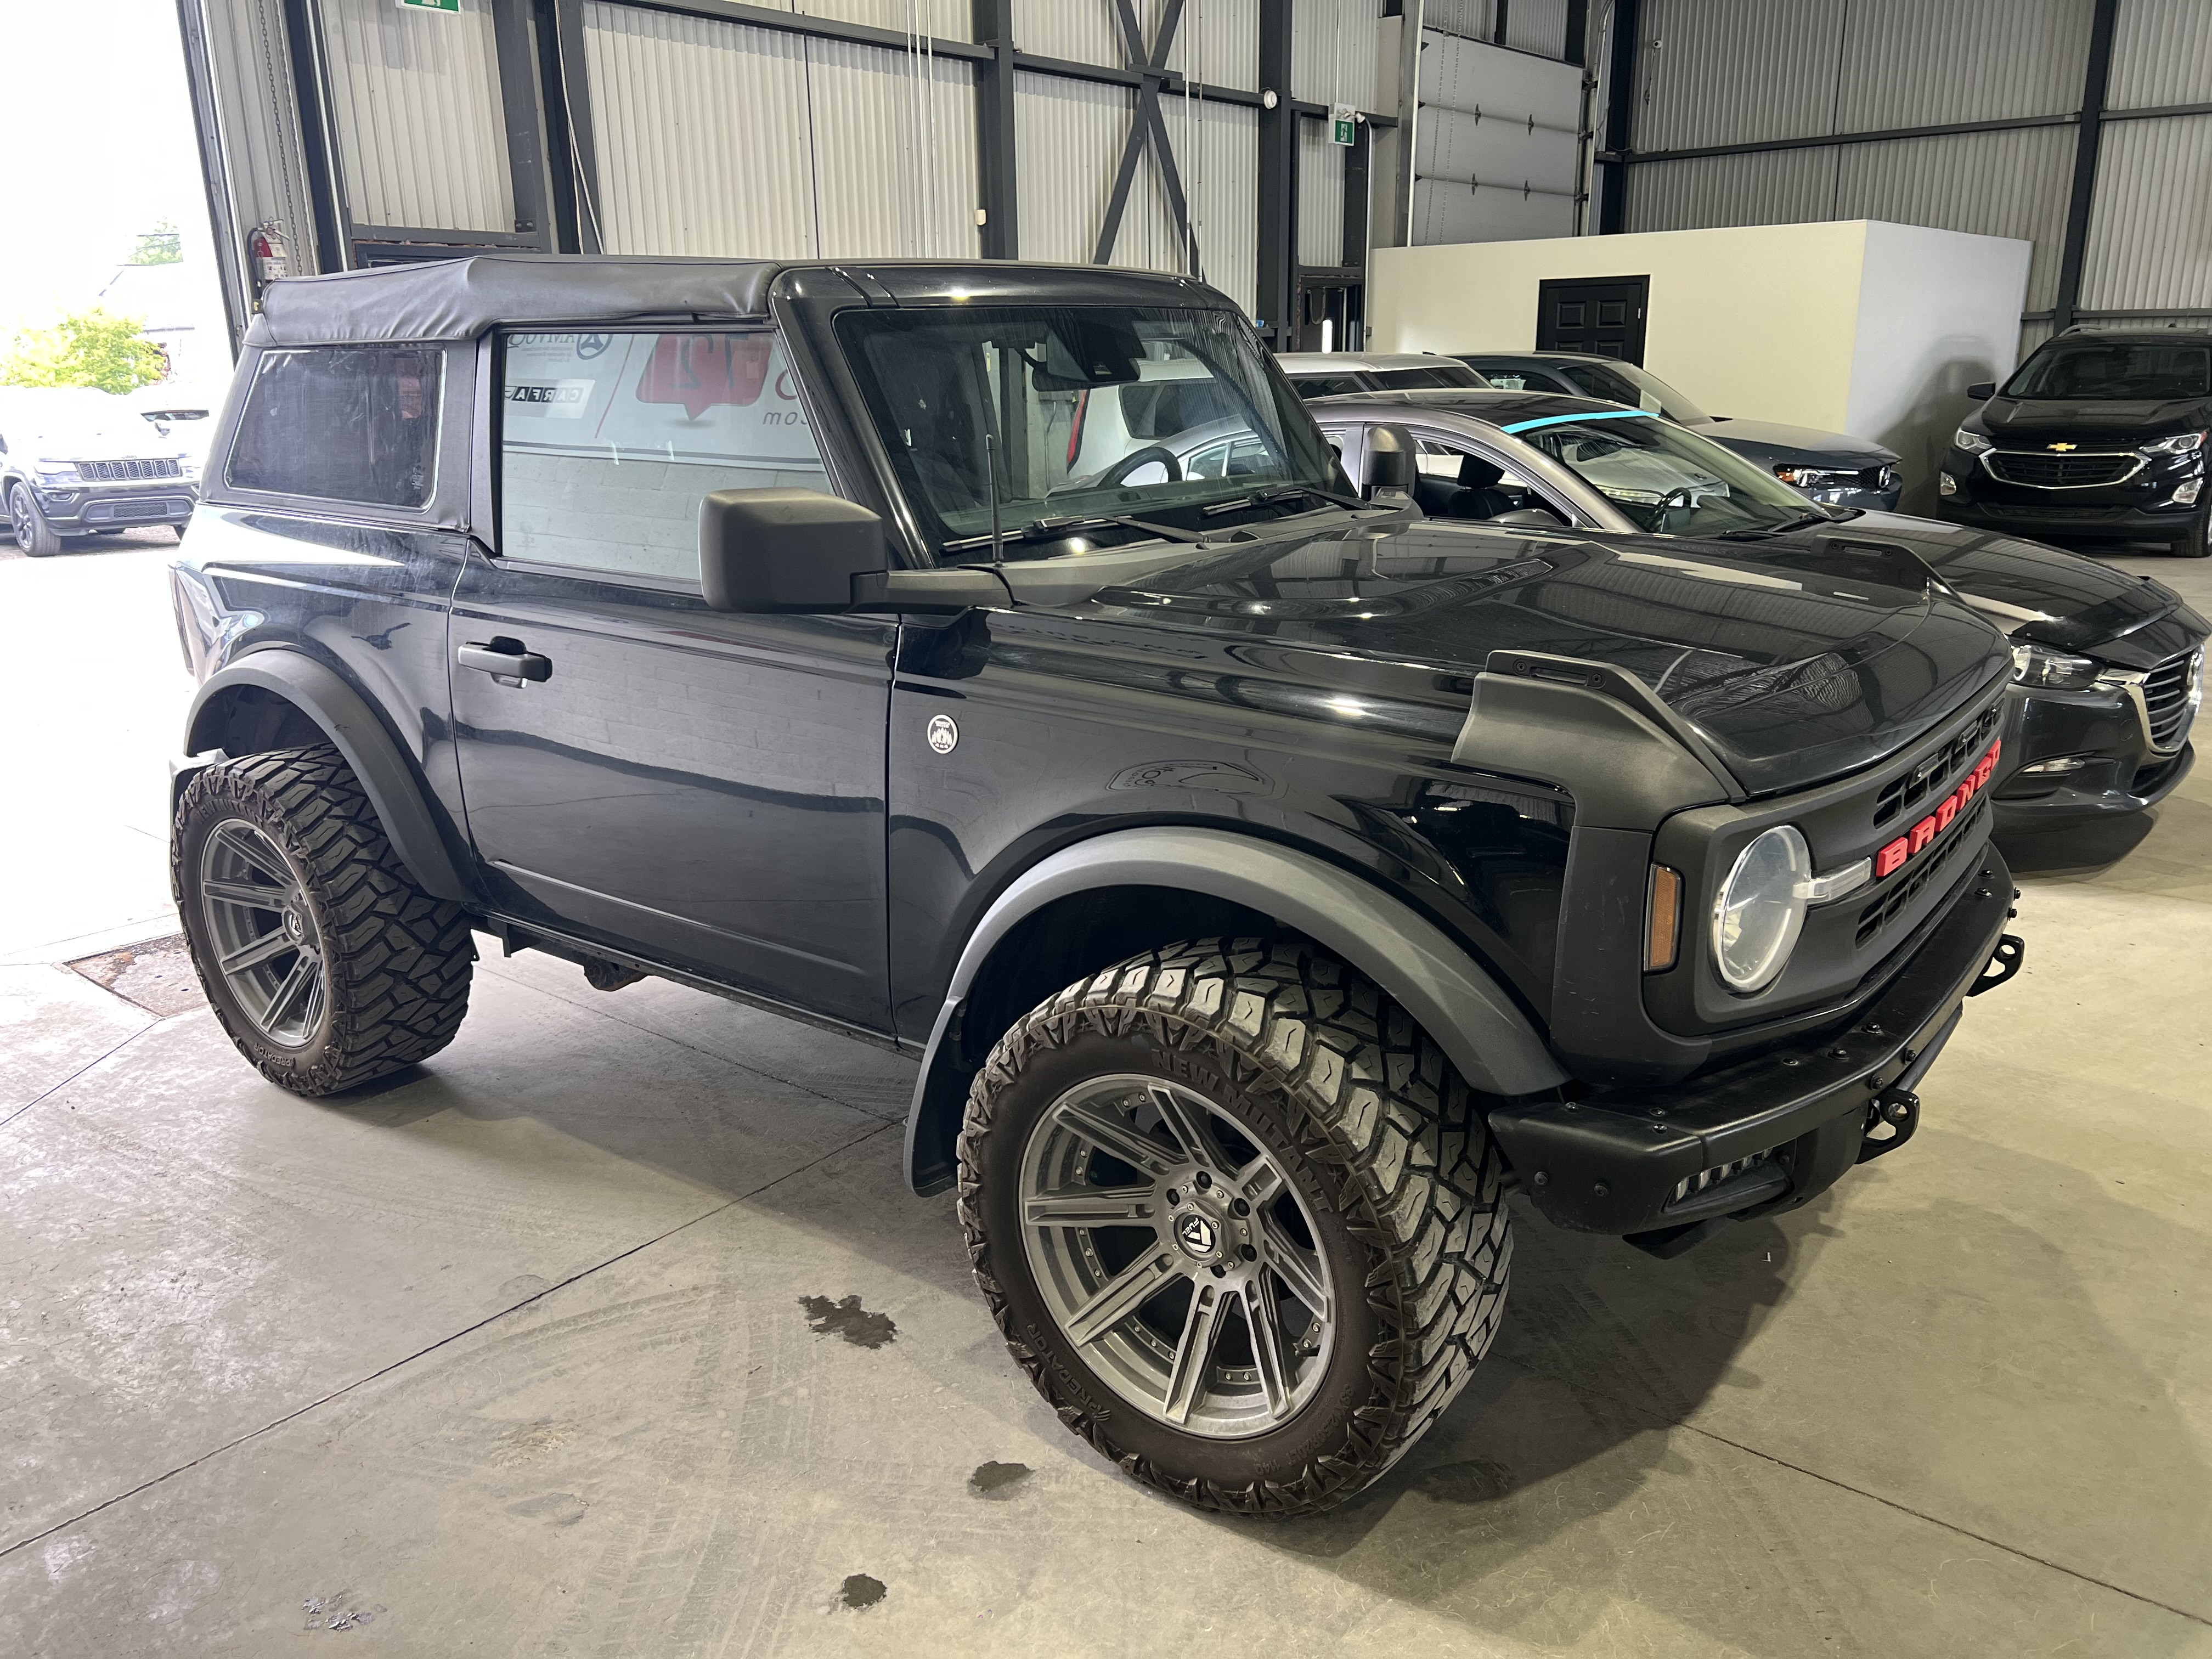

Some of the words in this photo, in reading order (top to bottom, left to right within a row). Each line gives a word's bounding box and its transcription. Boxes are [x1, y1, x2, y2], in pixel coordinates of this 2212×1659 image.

[1876, 739, 2001, 877] BRONCO
[253, 1042, 291, 1067] PREDATOR
[1152, 1048, 1219, 1091] NEW
[1223, 1084, 1334, 1214] MUTANT
[1182, 1217, 1200, 1235] FUEL
[1027, 1322, 1102, 1412] PREDATOR
